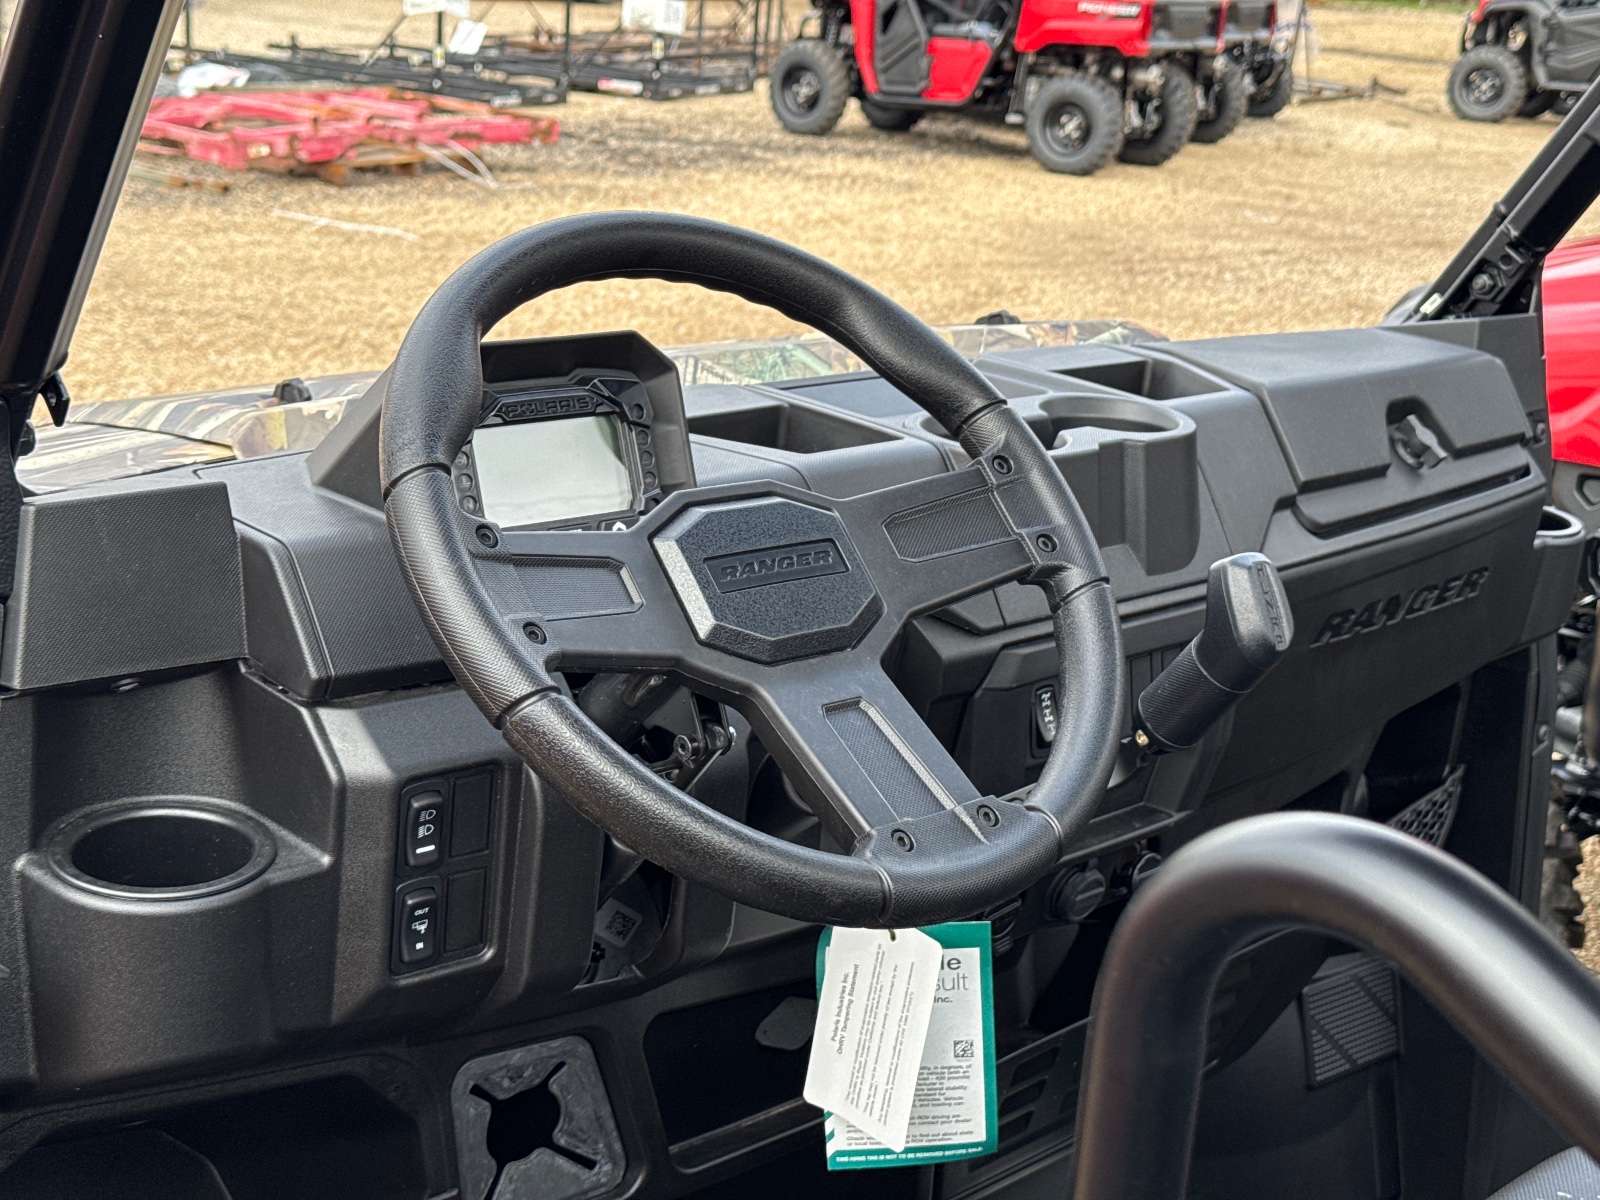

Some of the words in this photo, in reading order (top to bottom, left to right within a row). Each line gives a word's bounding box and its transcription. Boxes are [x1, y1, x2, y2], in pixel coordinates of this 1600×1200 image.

[505, 397, 592, 418] POLARIS
[720, 549, 833, 581] RANGER
[1310, 566, 1490, 648] RANGER
[414, 906, 430, 916] OUT
[831, 1019, 840, 1042] Polaris
[836, 985, 846, 1017] Industries
[837, 1034, 845, 1054] OHRV
[841, 999, 853, 1032] Tampering
[848, 964, 859, 997] Statement
